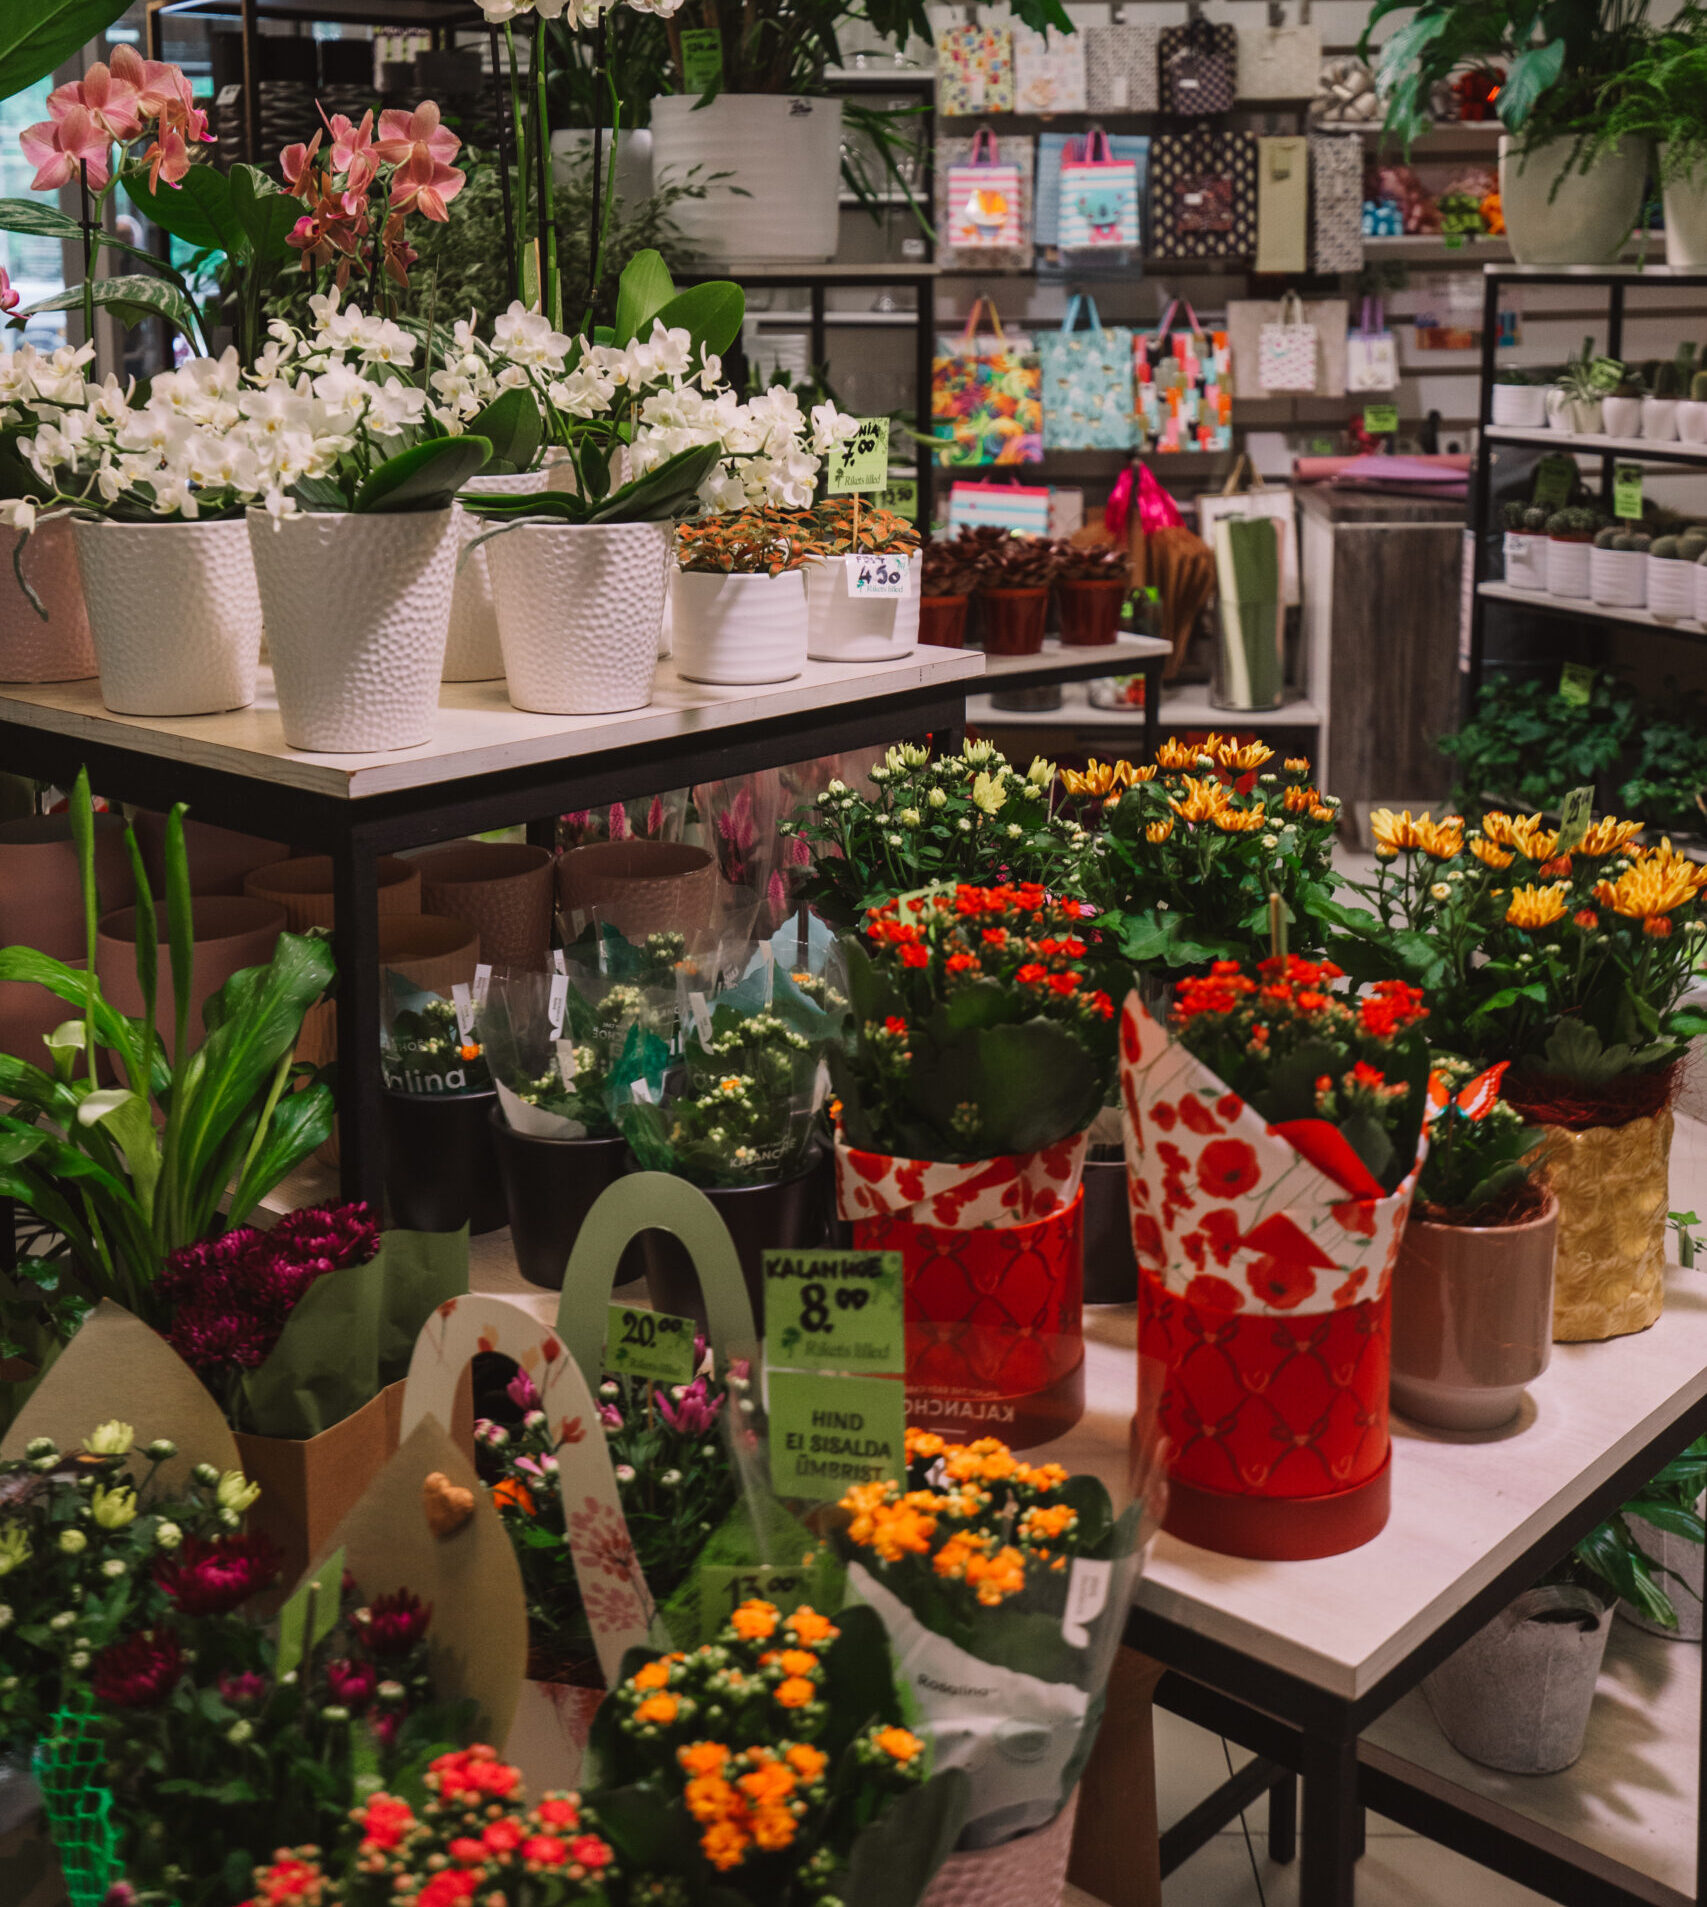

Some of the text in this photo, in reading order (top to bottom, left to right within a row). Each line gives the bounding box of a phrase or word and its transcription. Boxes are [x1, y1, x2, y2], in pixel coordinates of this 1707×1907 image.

[855, 422, 879, 438] NIA
[811, 1409, 865, 1431] HIND
[785, 1432, 892, 1458] EI SISALDA
